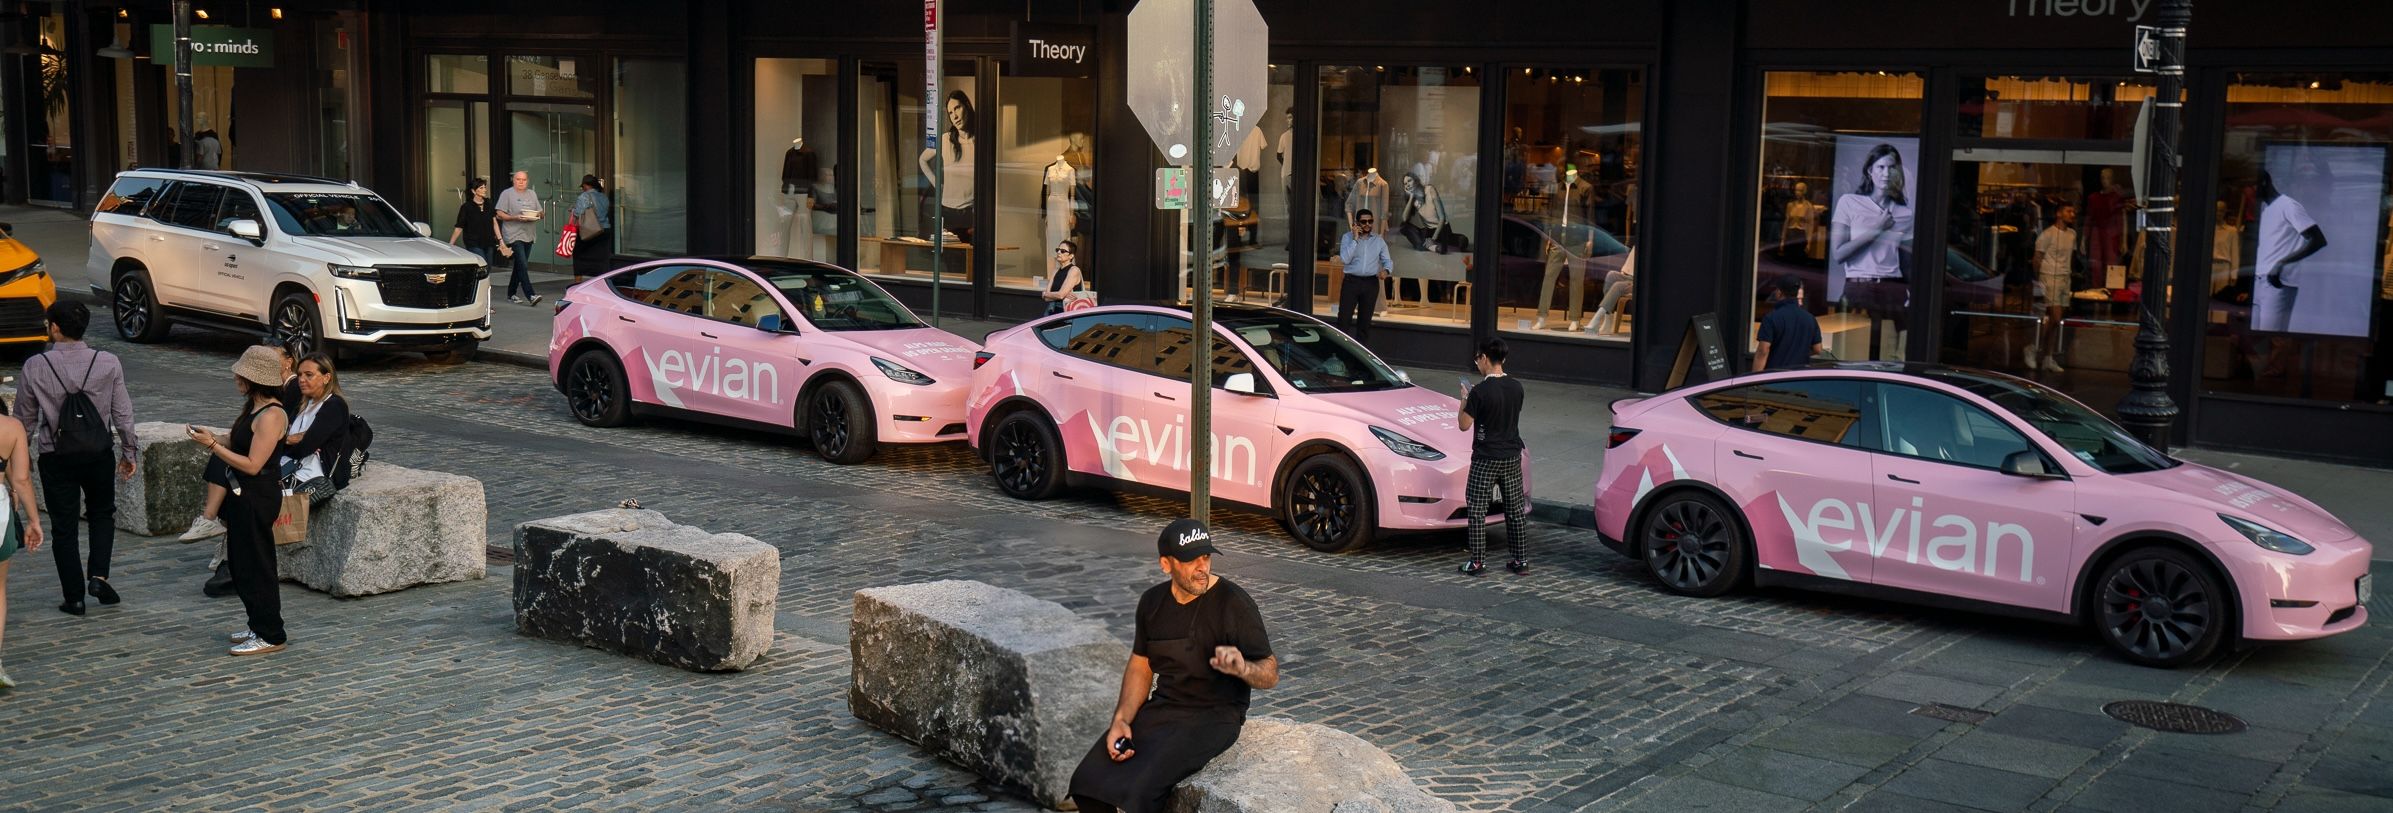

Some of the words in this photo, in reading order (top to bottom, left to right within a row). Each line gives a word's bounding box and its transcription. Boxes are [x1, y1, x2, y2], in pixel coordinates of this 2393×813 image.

[214, 39, 259, 54] minds
[1029, 39, 1086, 63] Theory
[659, 346, 778, 404] evian
[1807, 497, 2035, 582] evian
